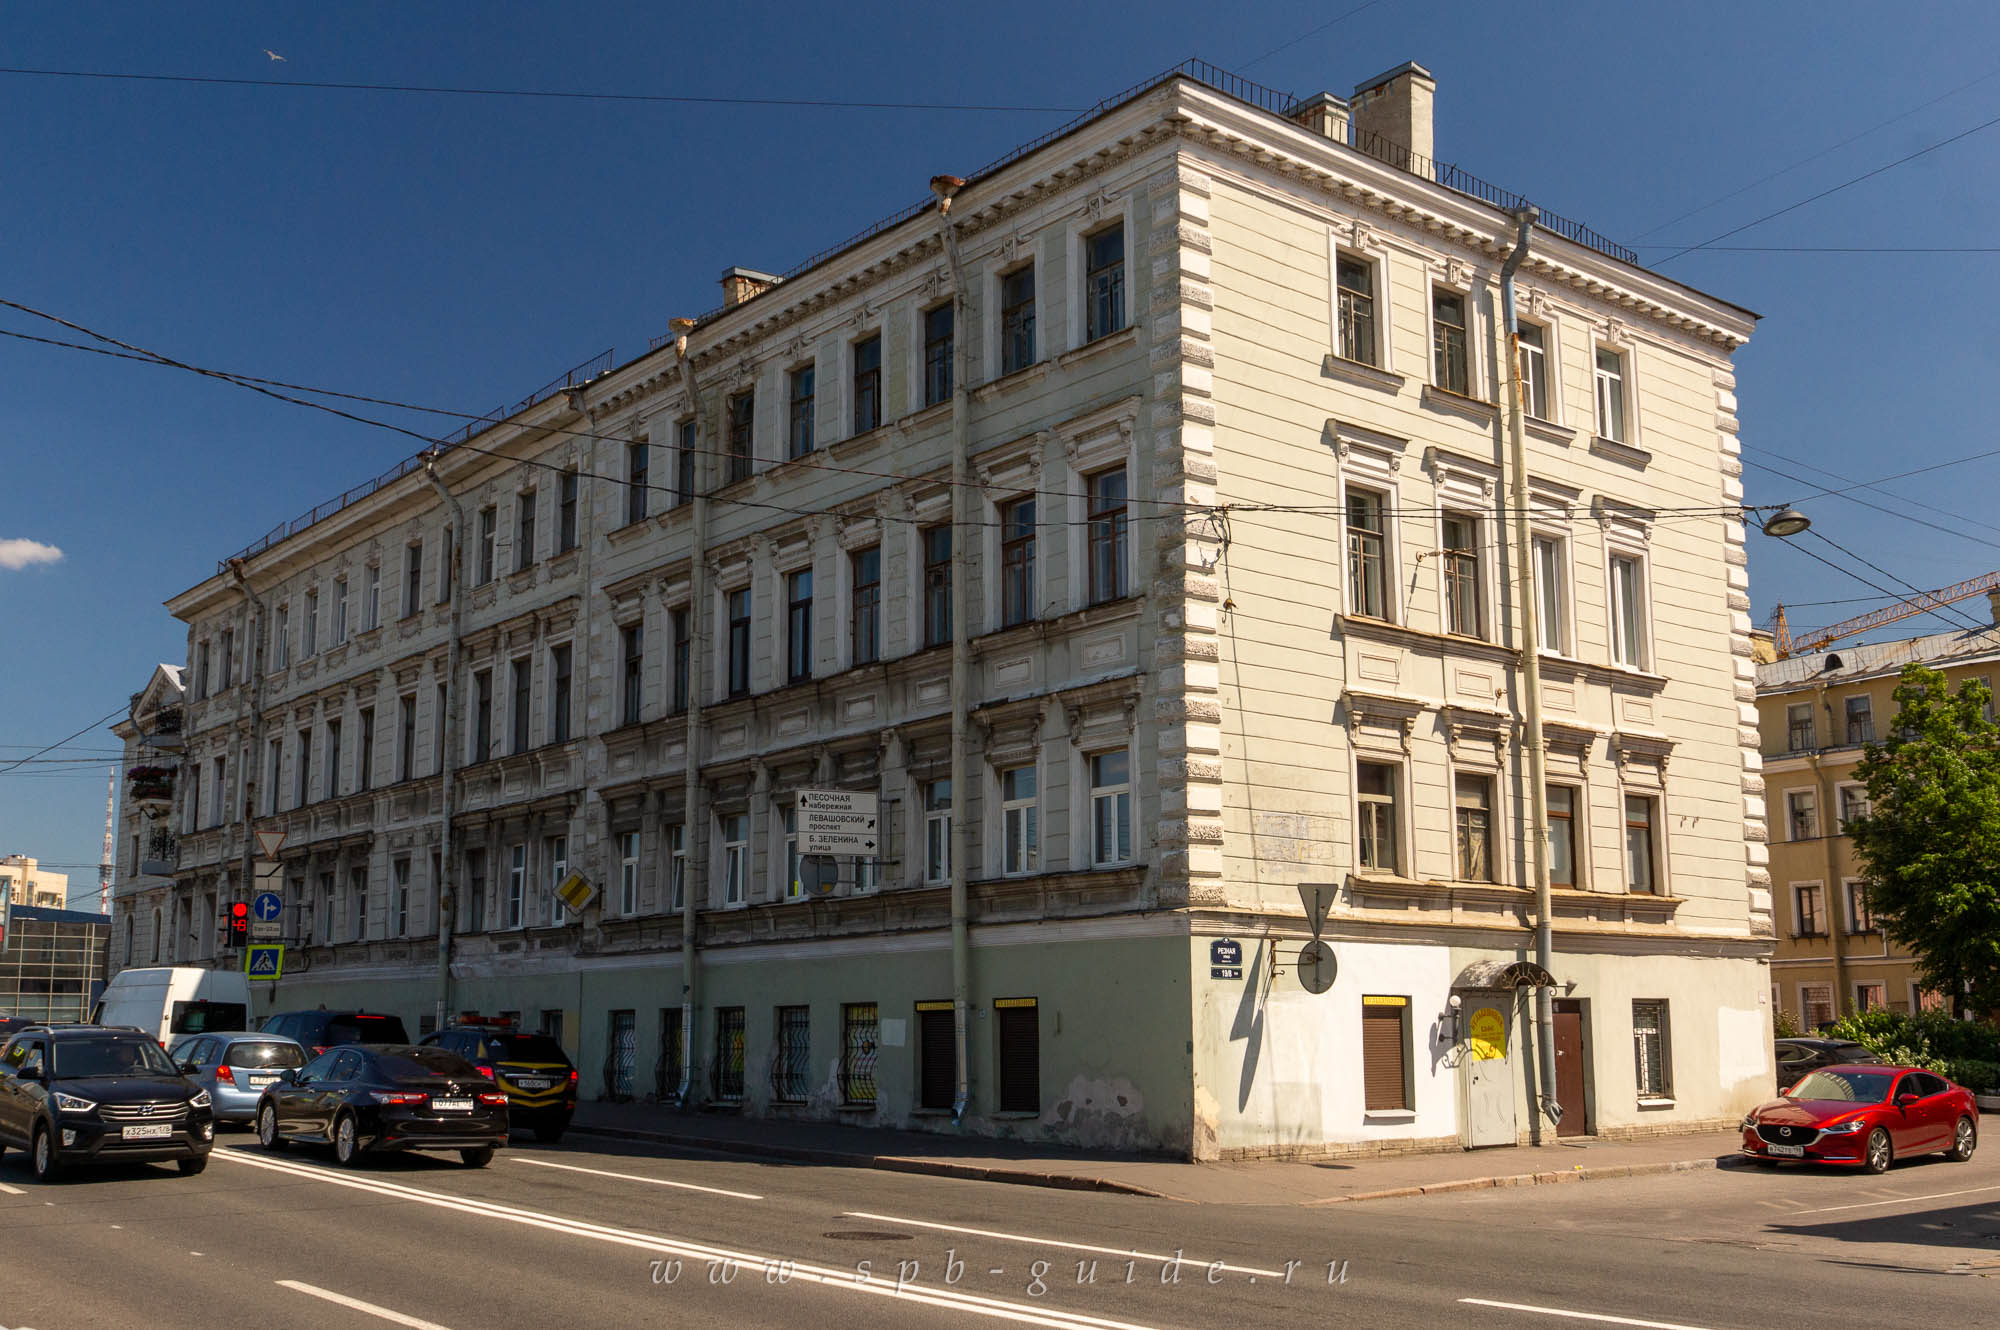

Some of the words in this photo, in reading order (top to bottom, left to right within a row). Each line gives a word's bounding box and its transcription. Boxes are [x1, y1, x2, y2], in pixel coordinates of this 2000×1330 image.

[808, 793, 851, 803] ПЕСОЧНАЯ
[808, 802, 852, 810] набережная
[808, 814, 865, 824] ЛЕВАШОВСКИЙ
[808, 823, 840, 831] проспект
[809, 835, 817, 843] Б.
[818, 835, 859, 844] ЗЕЛЕНИНА
[808, 844, 832, 852] улица
